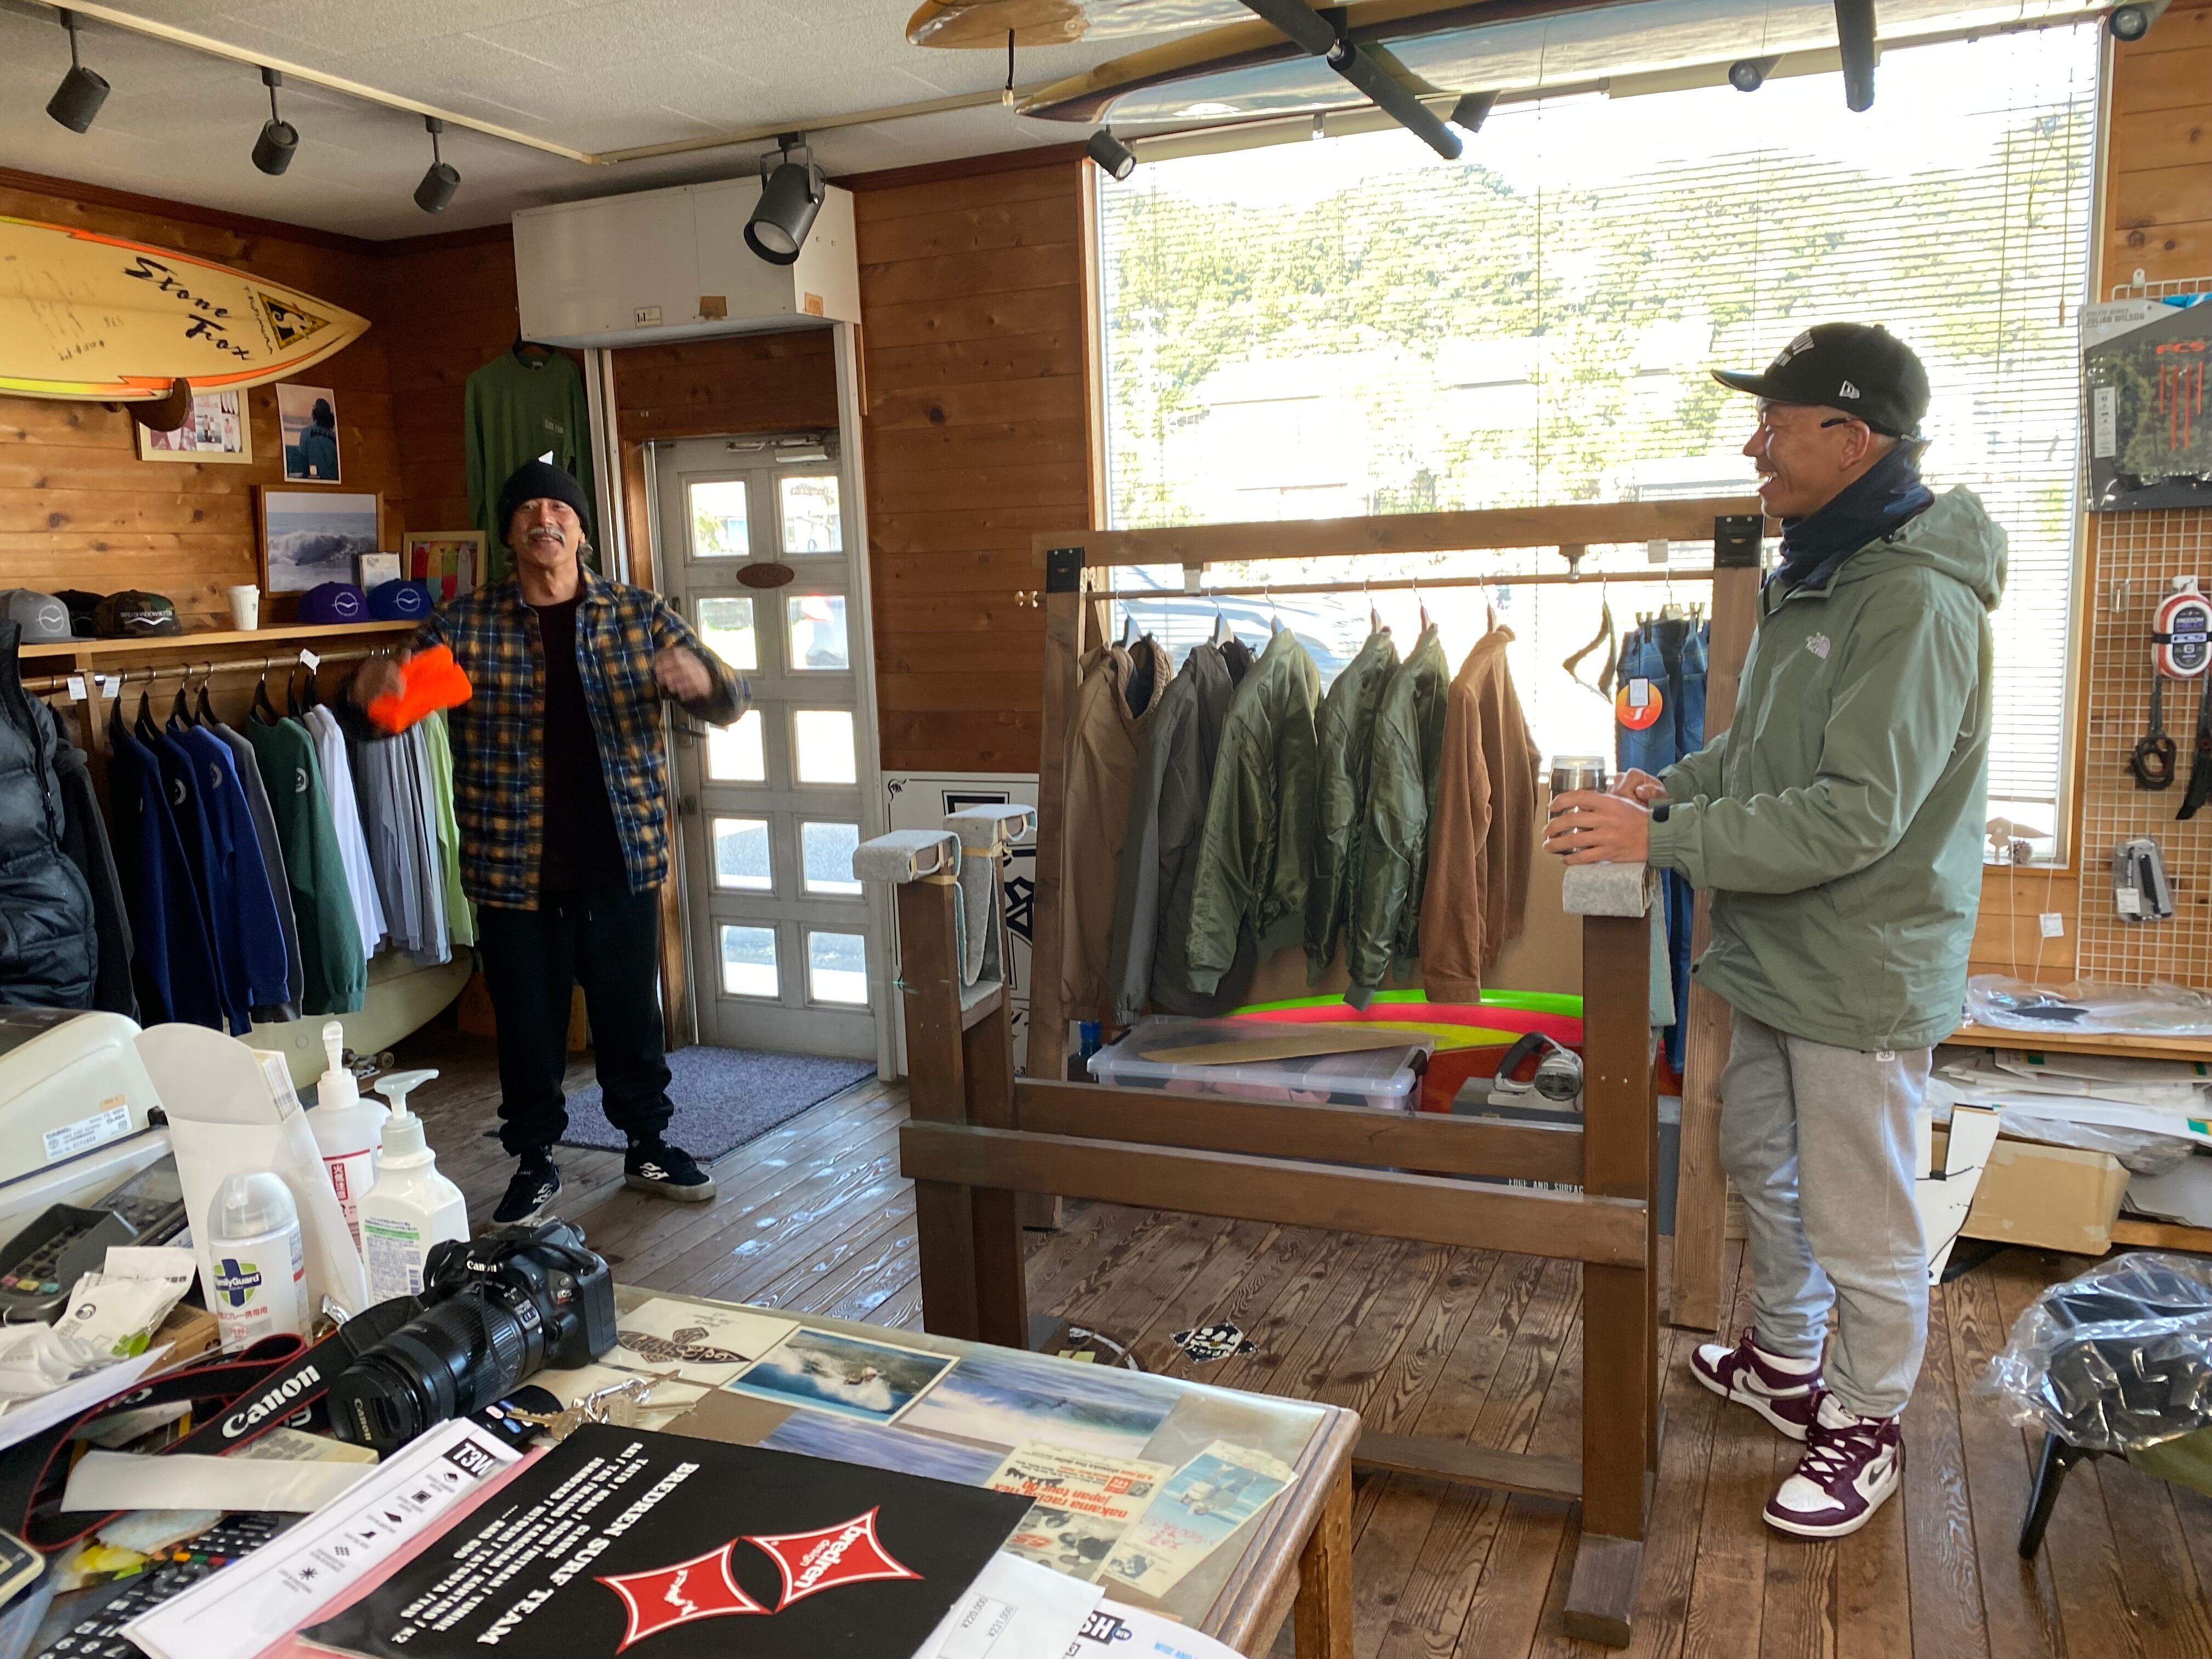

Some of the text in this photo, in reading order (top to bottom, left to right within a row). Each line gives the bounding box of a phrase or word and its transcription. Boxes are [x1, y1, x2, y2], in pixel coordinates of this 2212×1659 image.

[123, 256, 232, 317] Stone
[2086, 313, 2145, 325] JULIAN WILSON
[1509, 1178, 1584, 1194] EDGE AND SURFAC
[215, 1273, 259, 1289] milyGuard
[222, 1365, 321, 1438] Canon
[354, 1397, 372, 1441] Canon
[1041, 1483, 1069, 1499] tour
[1070, 1487, 1112, 1508] japan
[1069, 1498, 1128, 1521] nakama
[477, 1462, 700, 1645] BREDREN SURF TEAM
[545, 1525, 591, 1559] CLAUDE
[800, 1539, 831, 1566] design
[794, 1524, 866, 1589] bredren
[391, 1627, 417, 1644] K2
[1154, 1641, 1174, 1656] WIDE
